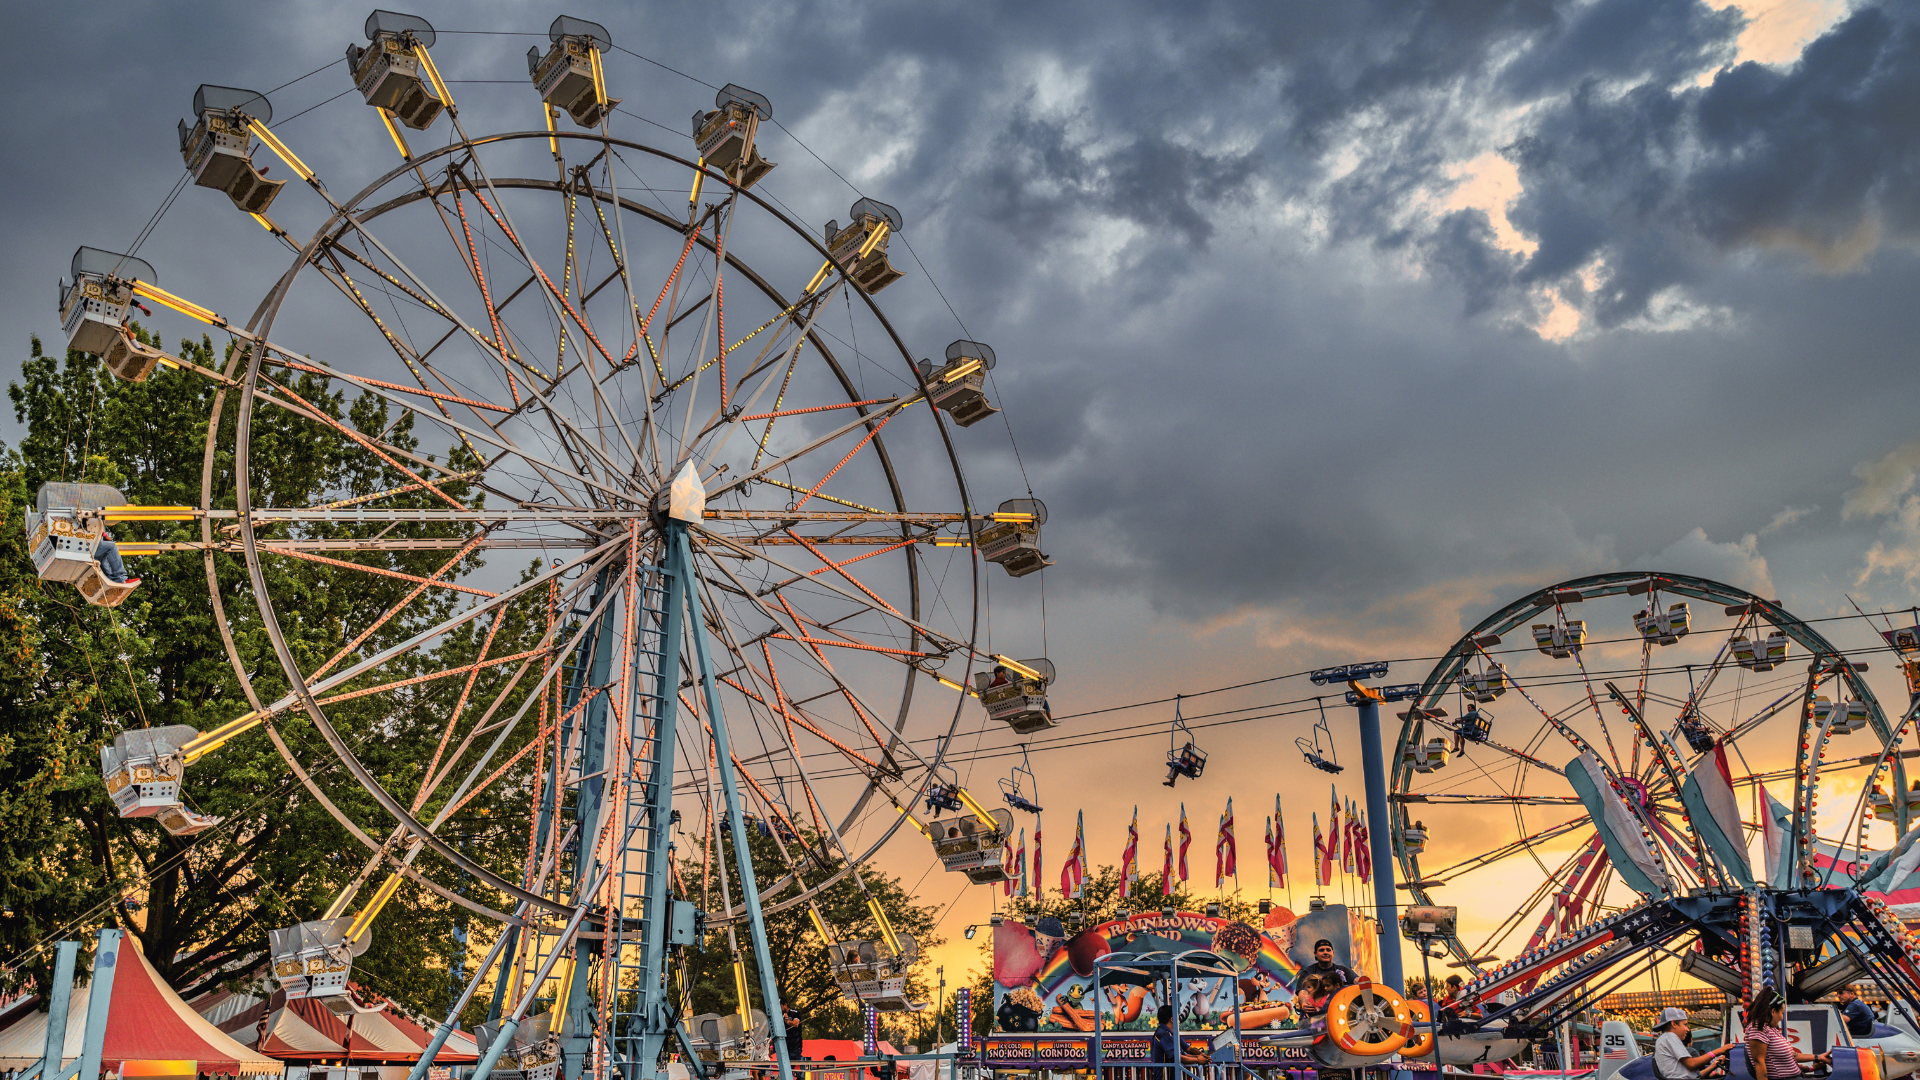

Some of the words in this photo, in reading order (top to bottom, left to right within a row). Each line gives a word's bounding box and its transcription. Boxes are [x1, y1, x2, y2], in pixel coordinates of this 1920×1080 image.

[1108, 916, 1218, 938] RAINBOW'S
[1605, 1035, 1625, 1046] 35
[1041, 1049, 1063, 1058] CORN
[1064, 1049, 1086, 1058] DOGS
[1106, 1049, 1146, 1058] APPLES
[1248, 1048, 1275, 1058] DOGS
